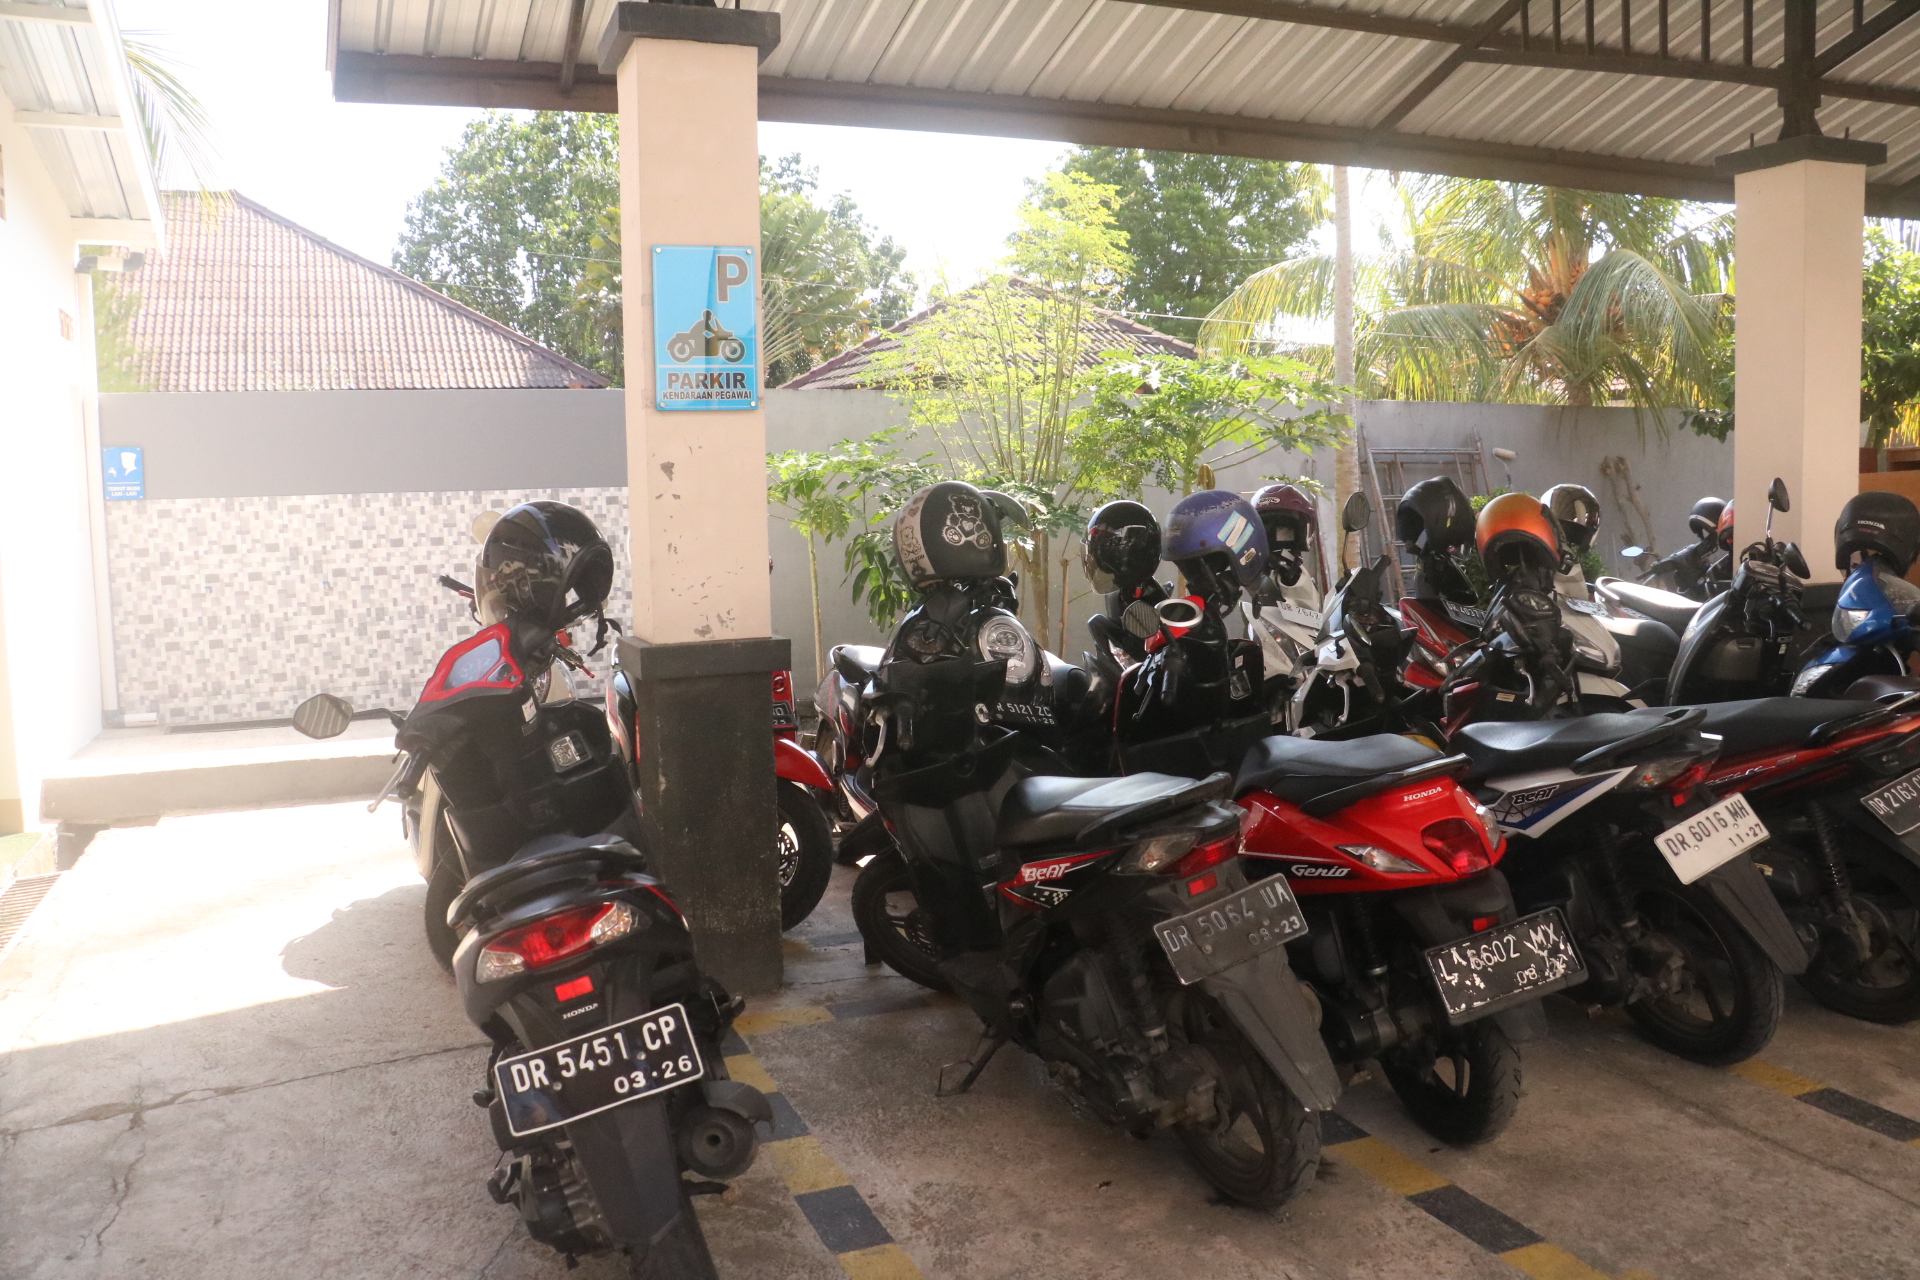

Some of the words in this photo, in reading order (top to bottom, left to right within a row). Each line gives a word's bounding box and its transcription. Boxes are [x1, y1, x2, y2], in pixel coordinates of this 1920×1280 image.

[716, 254, 749, 303] P
[667, 371, 747, 390] PARKIR
[662, 390, 713, 400] KENDARAAN
[715, 390, 752, 400] PEGAWAI
[1857, 519, 1886, 530] HONDA
[1006, 703, 1033, 715] 5121
[1035, 705, 1052, 717] ZC
[1403, 786, 1443, 801] HONDA
[1868, 797, 1890, 815] DR
[1884, 782, 1918, 807] 2163
[1663, 833, 1691, 857] DR
[1688, 811, 1728, 843] 6016
[1724, 799, 1750, 822] MH
[1290, 864, 1351, 877] Genio
[1163, 925, 1194, 952] DR
[1196, 897, 1255, 937] 5064
[1259, 881, 1291, 909] UA
[562, 1002, 599, 1020] HONDA
[510, 1058, 550, 1093] DR
[556, 1032, 628, 1078] 5451
[642, 1015, 676, 1051] CP
